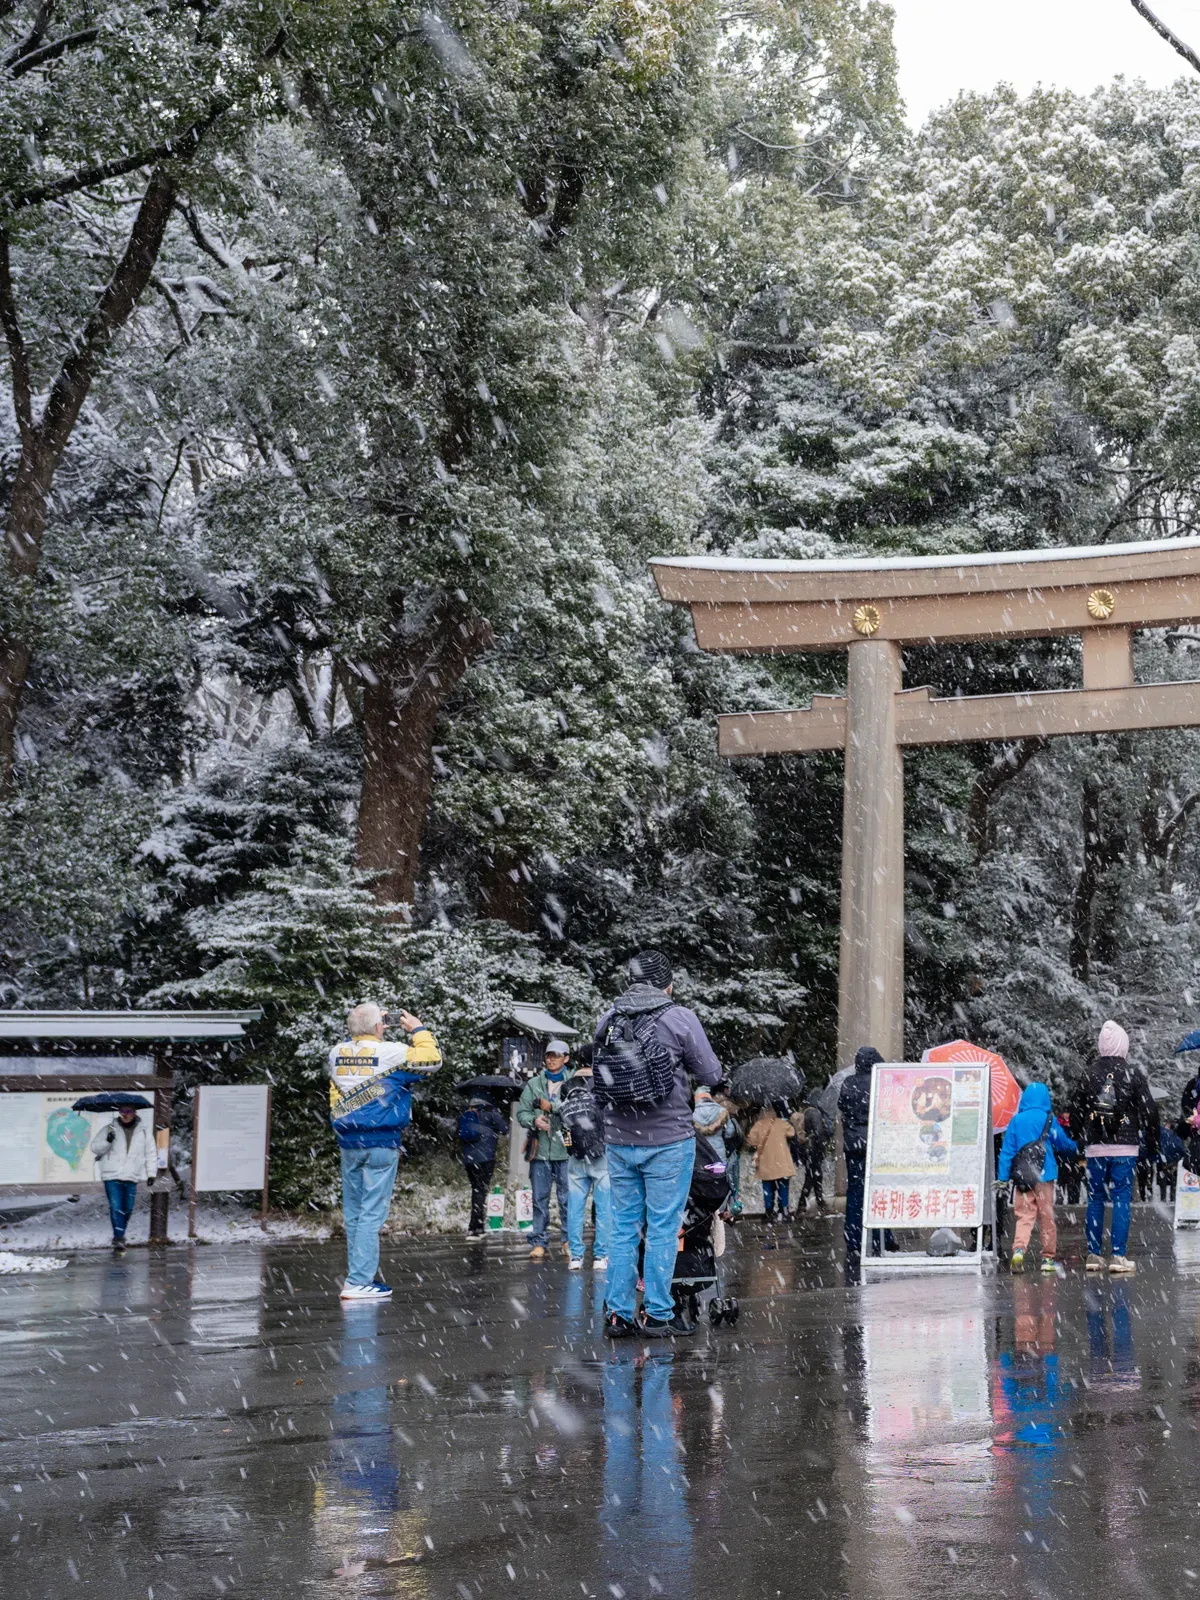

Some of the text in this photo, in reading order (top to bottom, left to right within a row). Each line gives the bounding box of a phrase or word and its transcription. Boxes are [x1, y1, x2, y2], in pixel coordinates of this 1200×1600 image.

[871, 1187, 977, 1219] 特別参拝行事
